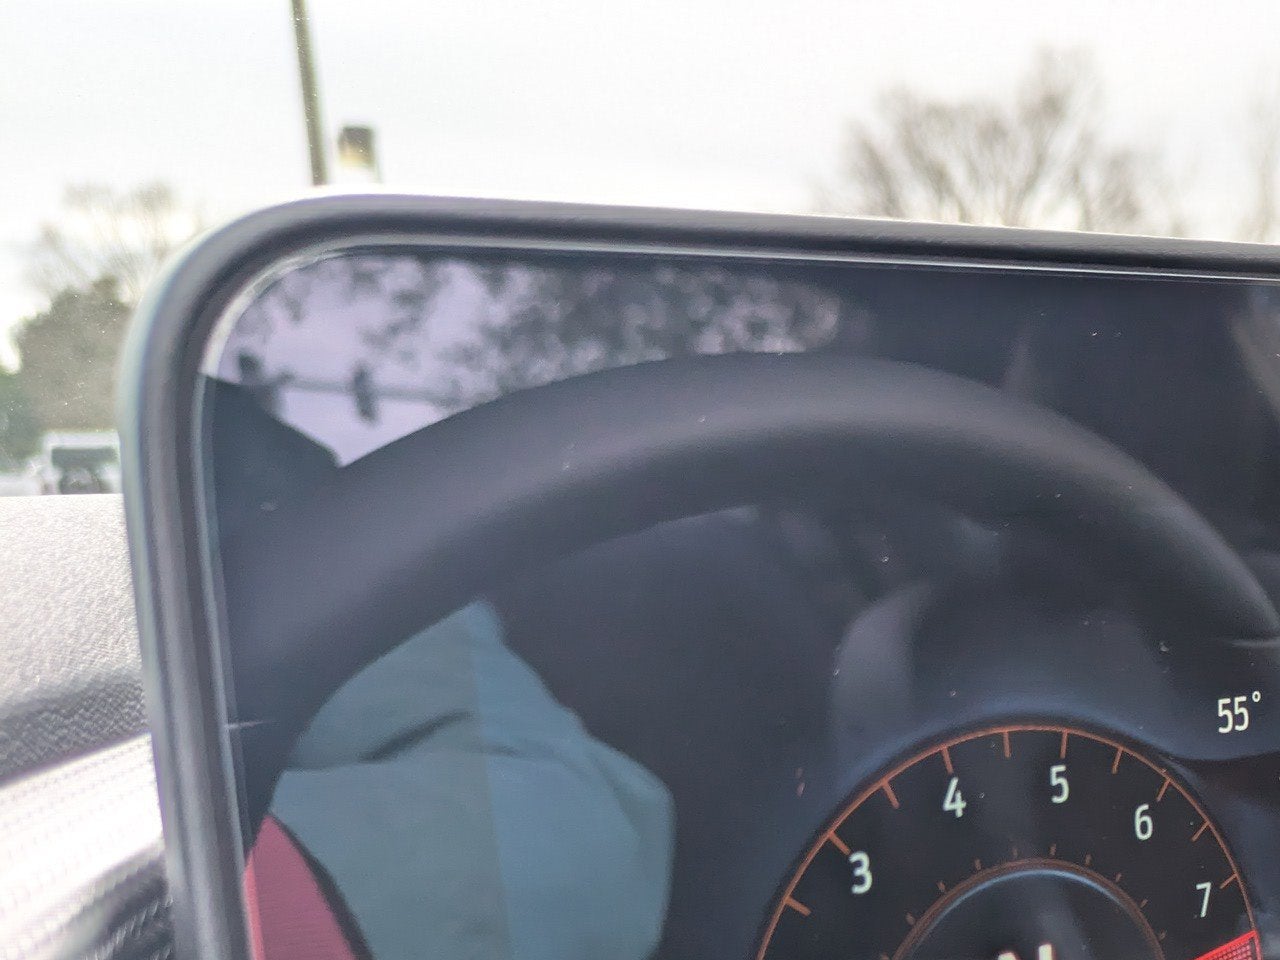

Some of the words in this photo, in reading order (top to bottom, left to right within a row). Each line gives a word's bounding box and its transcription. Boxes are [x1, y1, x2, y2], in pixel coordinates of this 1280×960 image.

[943, 777, 966, 818] 4
[1050, 766, 1069, 804] 5
[1134, 804, 1153, 840] 6
[853, 854, 873, 894] 3
[1195, 883, 1211, 918] 7
